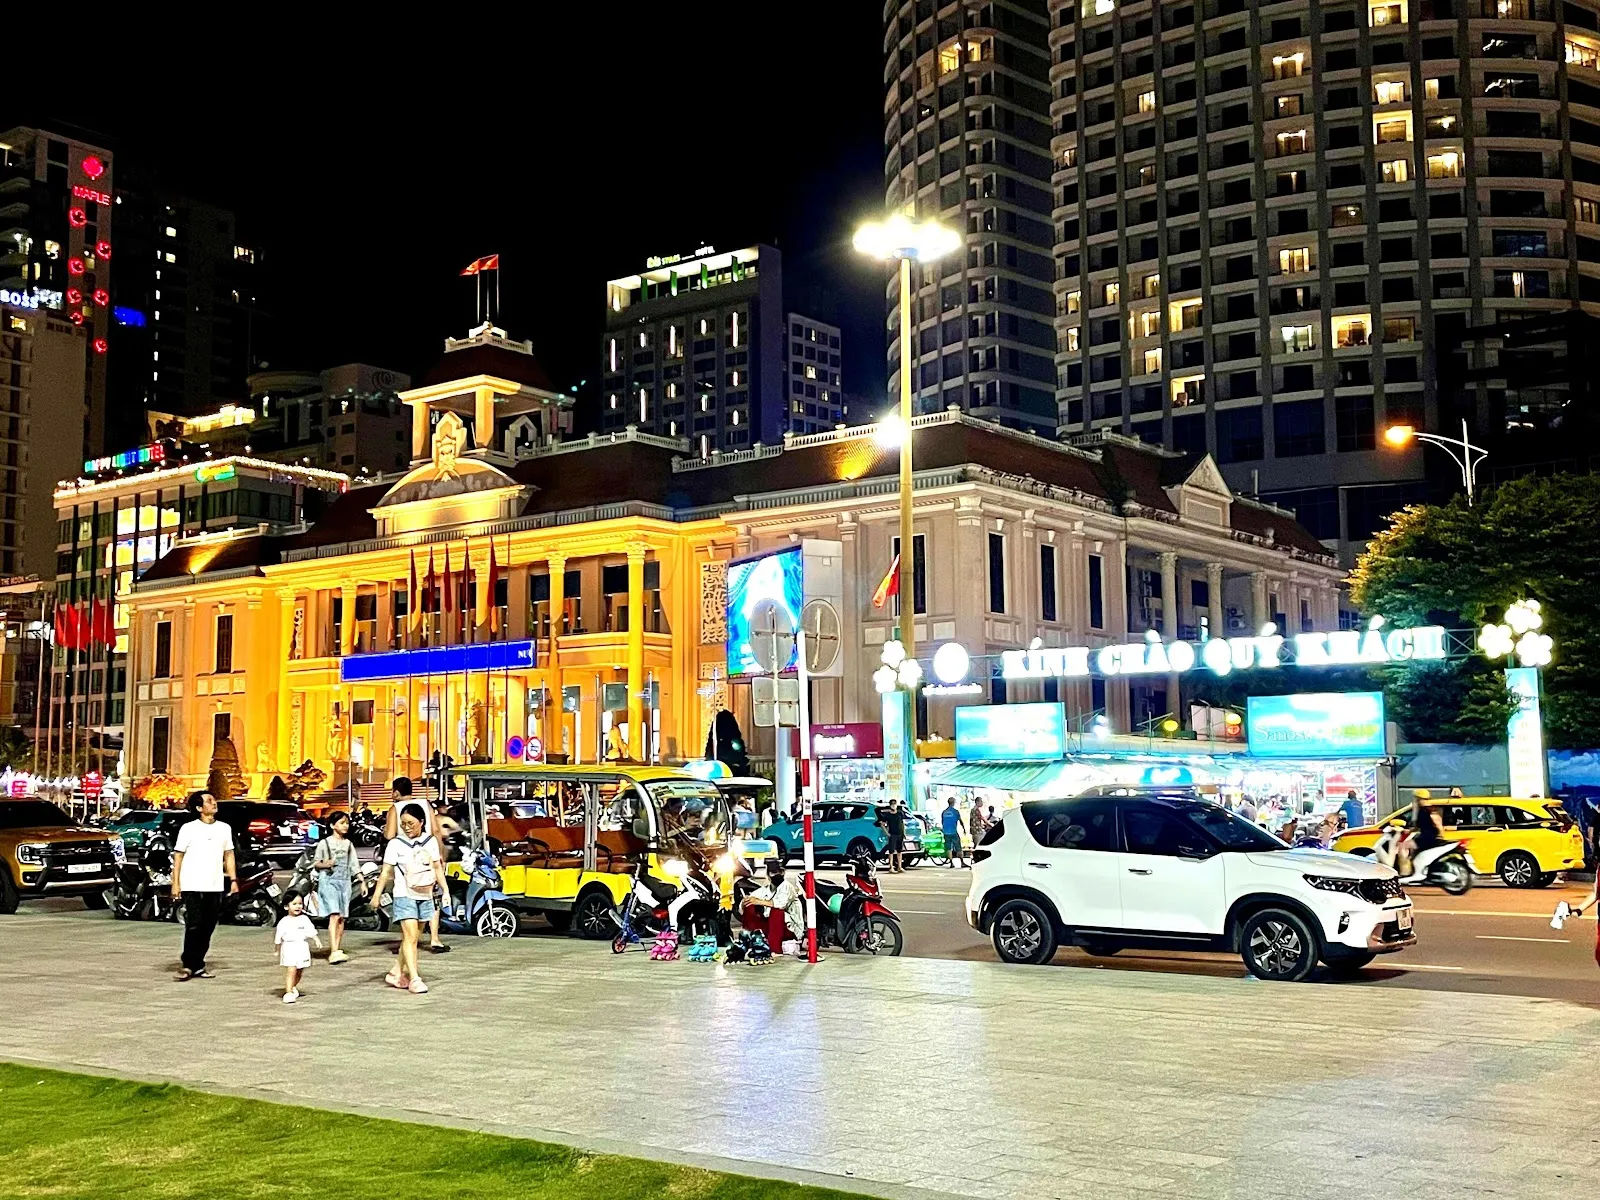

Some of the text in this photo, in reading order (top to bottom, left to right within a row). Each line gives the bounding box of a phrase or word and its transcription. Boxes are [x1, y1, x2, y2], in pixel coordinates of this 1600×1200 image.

[72, 185, 111, 206] MAPLE
[1002, 614, 1446, 678] KÍNH CHÀO QUÝ KHÁCH
